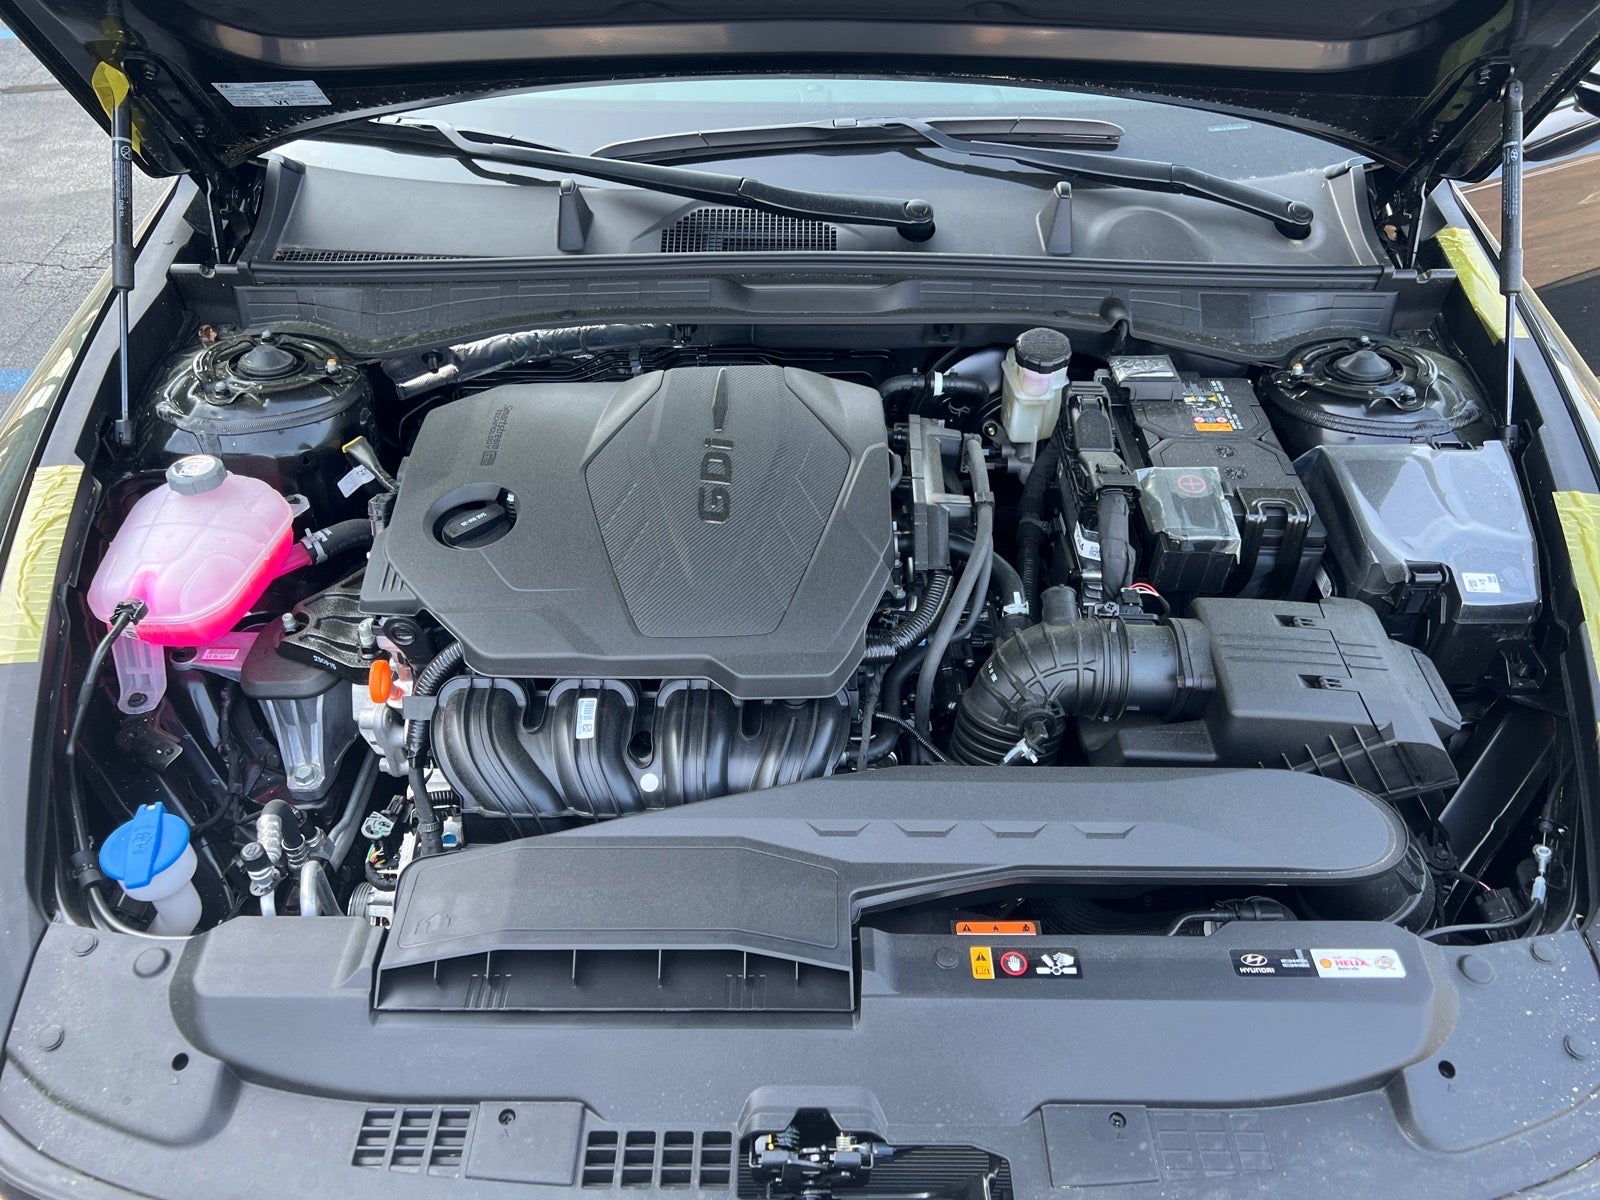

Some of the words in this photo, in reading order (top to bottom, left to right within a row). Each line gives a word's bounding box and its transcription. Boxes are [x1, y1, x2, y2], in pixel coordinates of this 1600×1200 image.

[485, 409, 503, 450] TECHNOLOGY
[491, 404, 513, 450] Smartstream
[698, 437, 734, 524] GDi
[1335, 959, 1369, 967] HELIX
